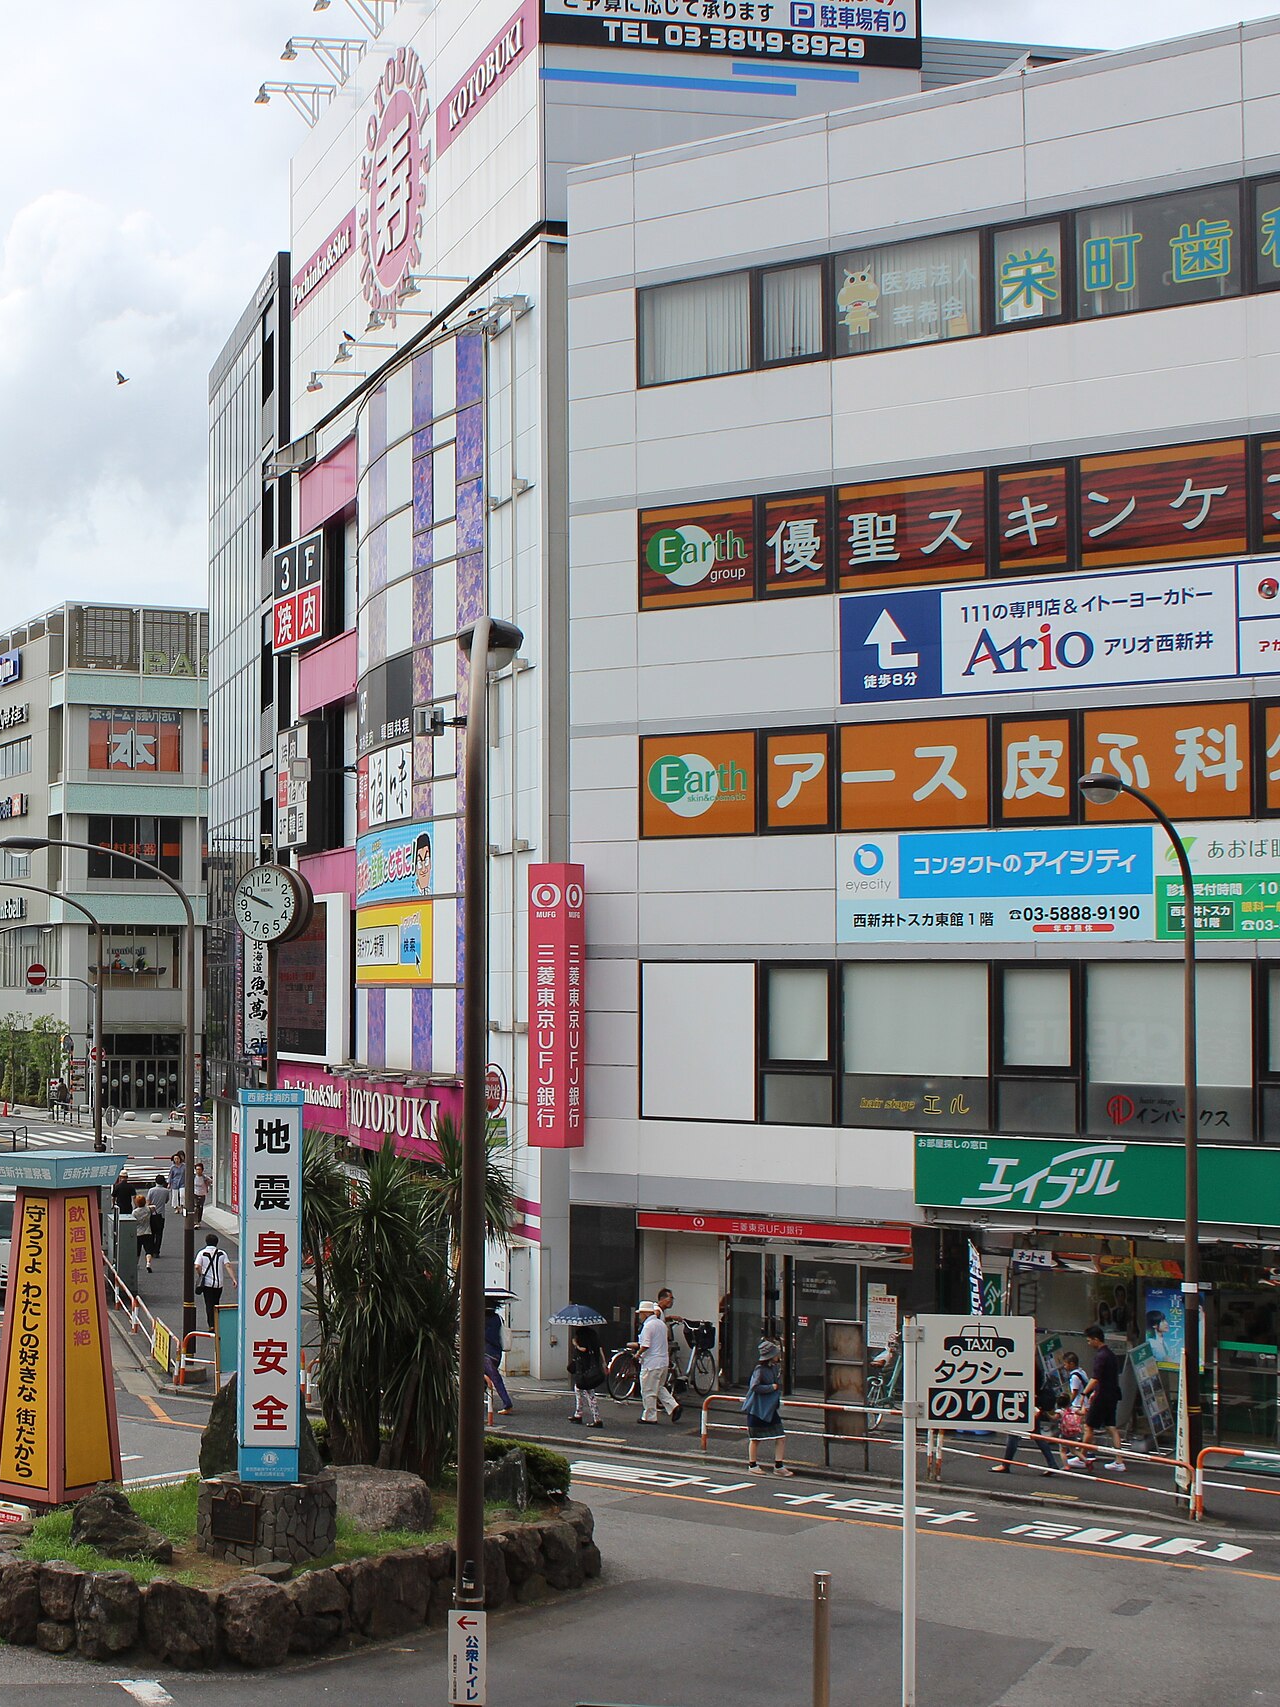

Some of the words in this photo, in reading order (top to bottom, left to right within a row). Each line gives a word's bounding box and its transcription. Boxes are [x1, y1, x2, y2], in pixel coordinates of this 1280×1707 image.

[820, 5, 907, 33] 駐車場有り
[603, 20, 659, 45] TEL
[664, 26, 866, 59] 03-3849-8929
[447, 18, 525, 132] KOTOBUKI
[880, 263, 976, 295] 医療法人
[658, 527, 749, 568] Earth
[280, 545, 316, 592] 3F
[710, 566, 747, 584] group
[276, 591, 317, 644] 焼肉
[961, 623, 1095, 678] Ario
[1104, 631, 1215, 656] アリオ西新井
[863, 671, 919, 690] 徒歩8分
[108, 727, 157, 768] 本
[660, 760, 748, 795] Earth
[913, 849, 1137, 877] コンタクトのアイシティ
[261, 873, 271, 884] 12
[281, 884, 288, 894] 2
[845, 877, 891, 893] eyecity
[240, 900, 248, 910] 9
[281, 910, 288, 920] 4
[284, 898, 291, 908] 3
[536, 911, 557, 919] MUFG
[568, 911, 581, 919] MUFG
[1023, 905, 1140, 924] 03-5888-9190
[244, 911, 252, 922] 8
[252, 921, 260, 931] 7
[262, 924, 269, 934] 6
[272, 920, 280, 930] 5
[1053, 924, 1094, 932] 年中無休
[536, 943, 557, 1129] 三菱東京UFJ銀行
[568, 943, 580, 1129] 三菱東京UFJ銀行
[247, 1091, 299, 1103] 西新井消防署
[923, 1093, 970, 1115] エル
[350, 1087, 440, 1142] KOTOBUKI
[917, 1138, 988, 1151] お部屋探しの窓口
[62, 1163, 118, 1180] 西新井警察署
[960, 1145, 1127, 1209] エイブル
[24, 1205, 47, 1275] 守ろうよ
[731, 1222, 804, 1236] 三菱東京UFJ銀行
[68, 1205, 91, 1346] 飲酒運転の根絶
[17, 1280, 43, 1403] わたしの好きな
[965, 1338, 994, 1351] TAXI
[933, 1359, 1024, 1385] タクシー
[931, 1390, 1028, 1420] のりば
[13, 1406, 38, 1478] 街だから
[465, 1635, 480, 1701] 公衆トイレ
